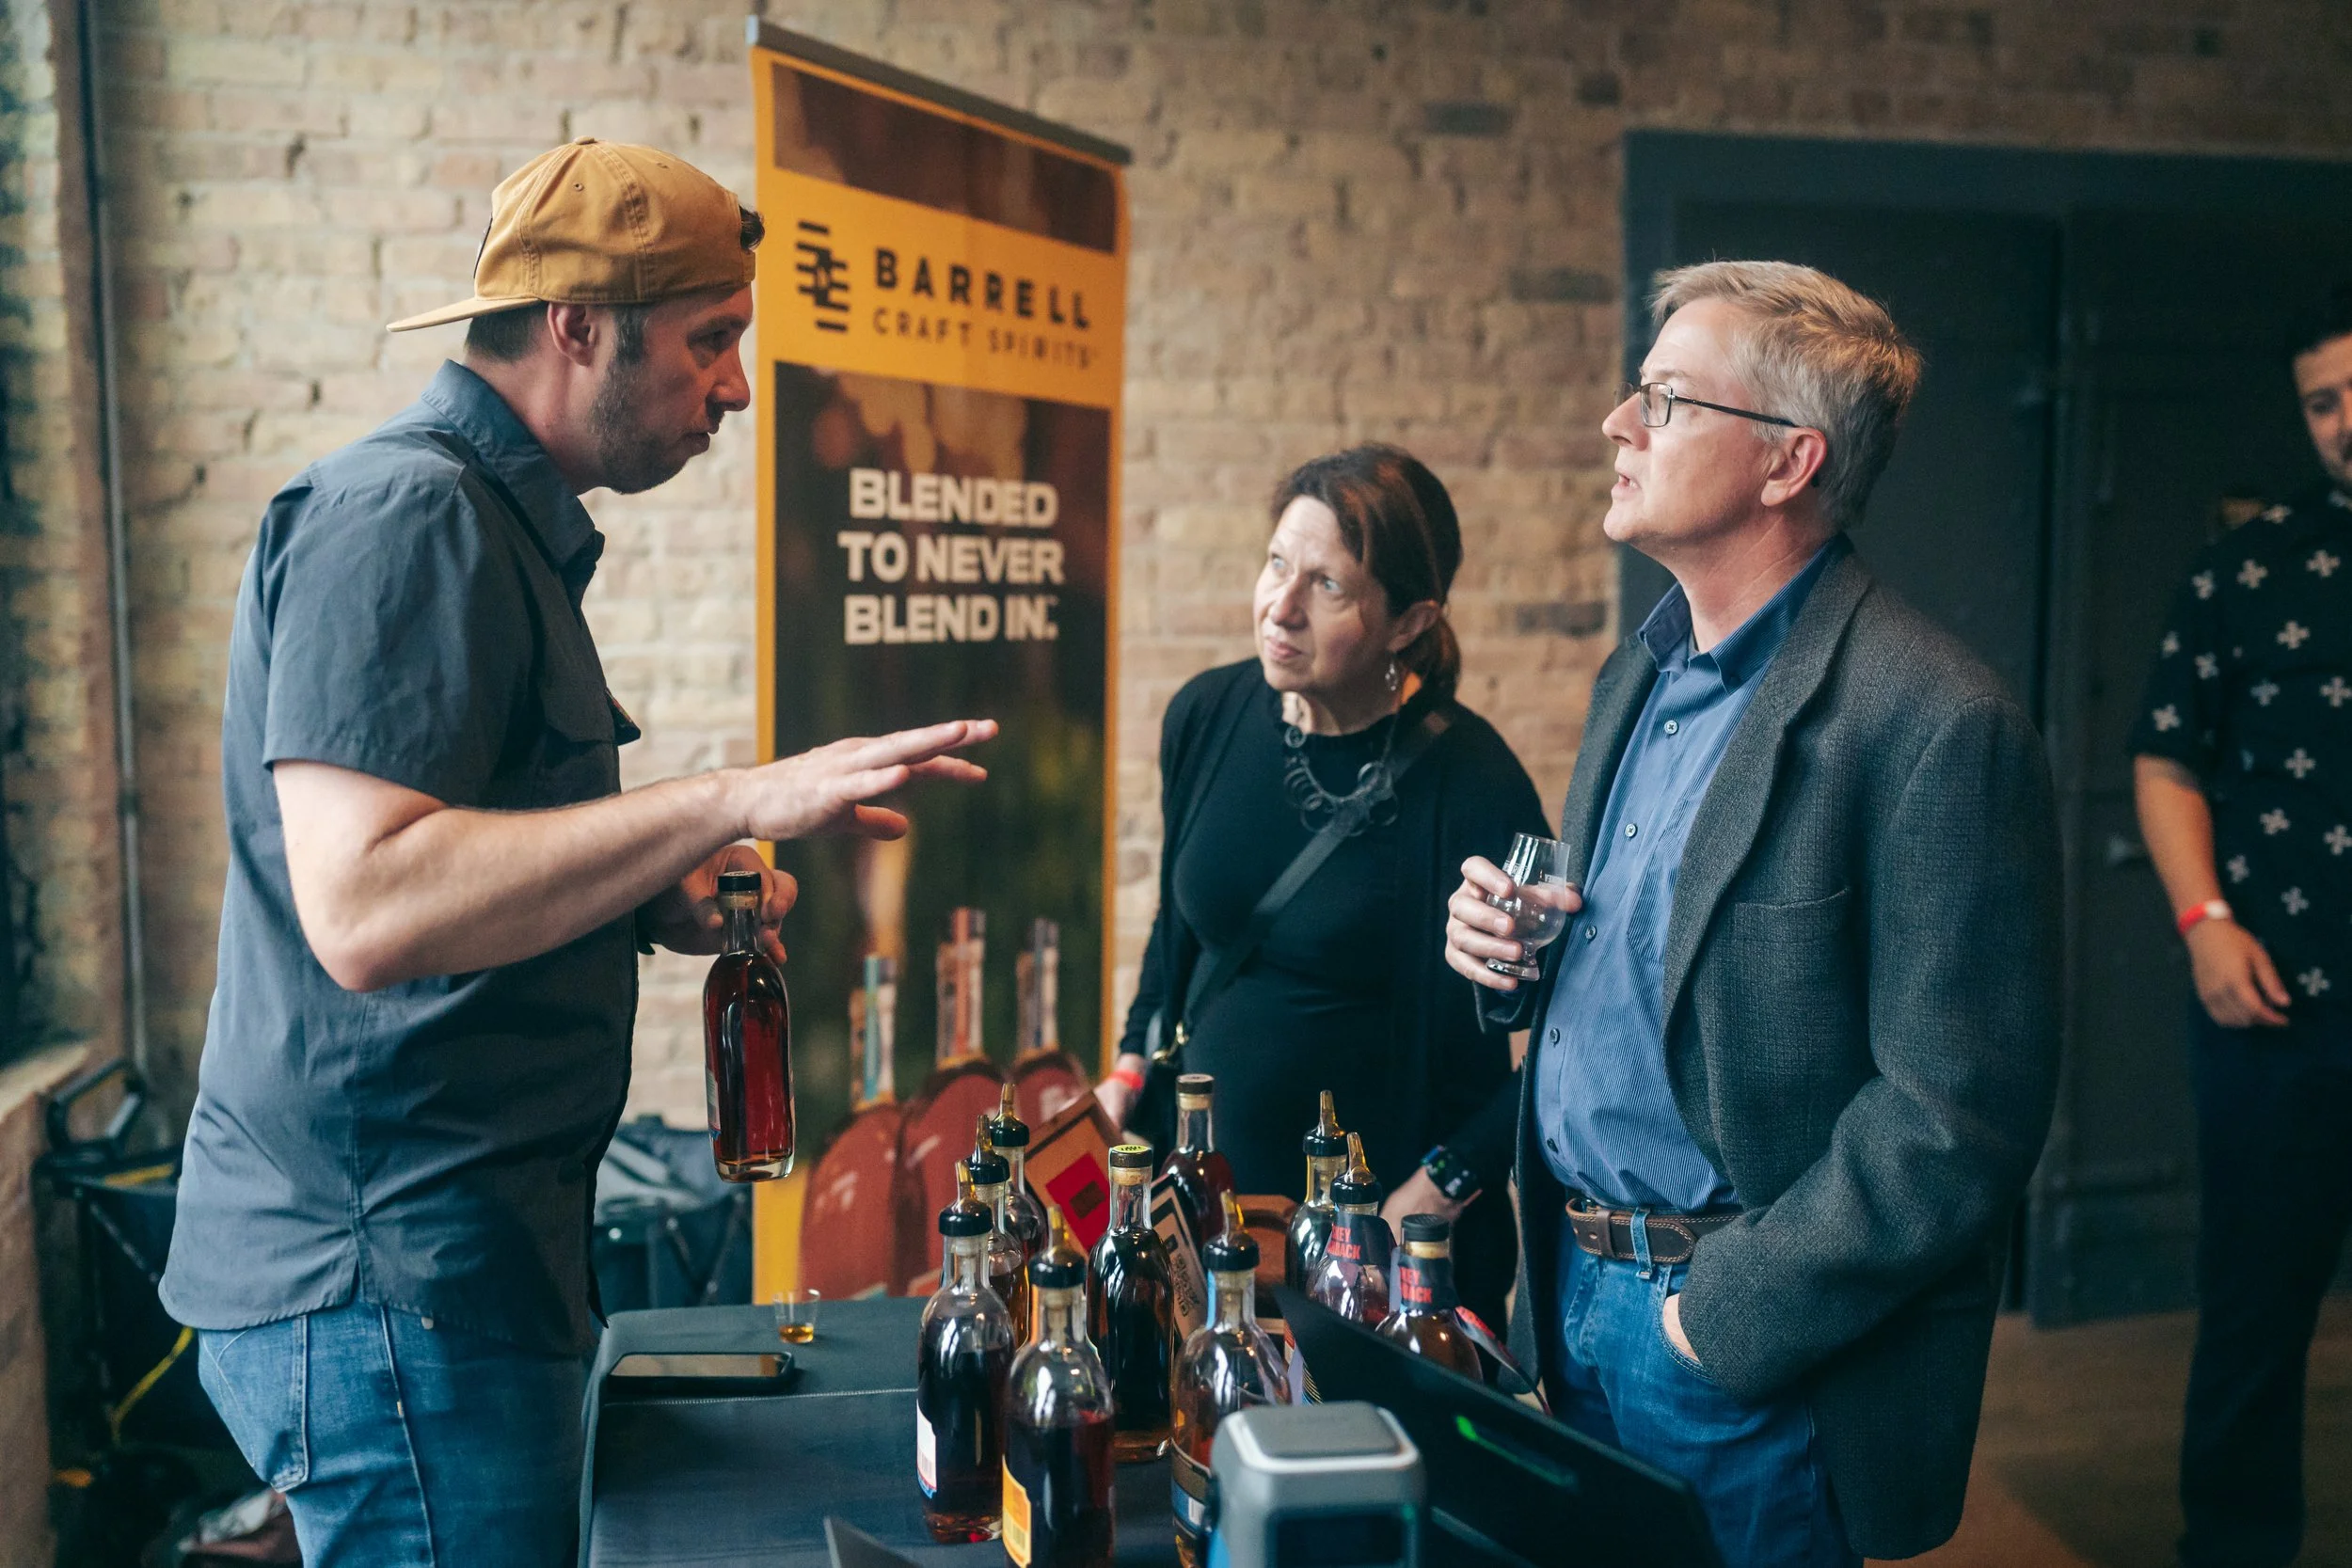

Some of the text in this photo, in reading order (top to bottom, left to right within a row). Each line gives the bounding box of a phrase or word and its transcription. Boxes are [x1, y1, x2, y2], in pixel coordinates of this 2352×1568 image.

[875, 247, 1089, 330] BARRELL
[873, 307, 972, 347] CRAFT
[850, 467, 1059, 528] BLENDED
[837, 531, 1066, 585] TO NEVER
[844, 594, 1000, 644] BLEND
